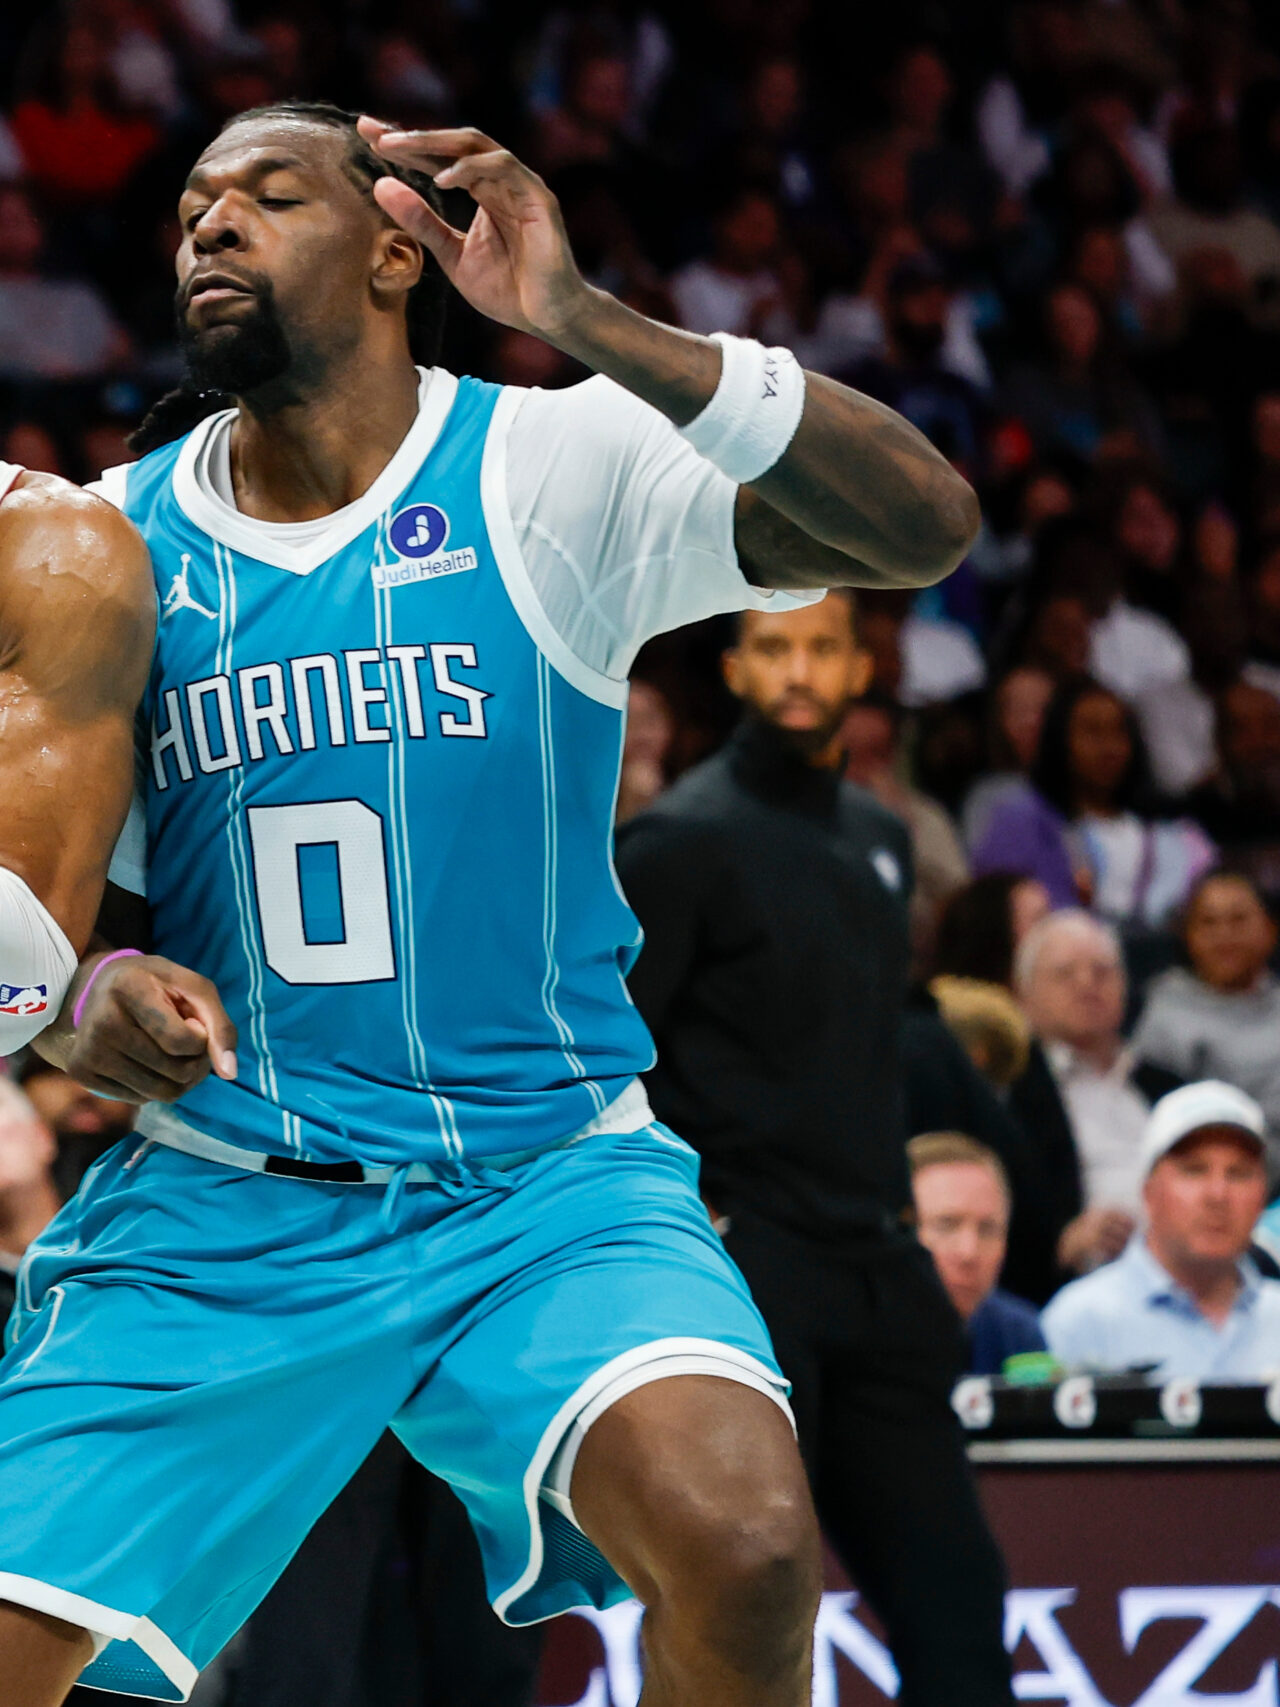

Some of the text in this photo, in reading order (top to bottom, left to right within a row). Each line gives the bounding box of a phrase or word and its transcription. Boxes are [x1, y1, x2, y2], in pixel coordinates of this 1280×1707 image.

[376, 550, 474, 585] Judi Health
[150, 643, 495, 792] HORNETS
[247, 798, 397, 986] 0
